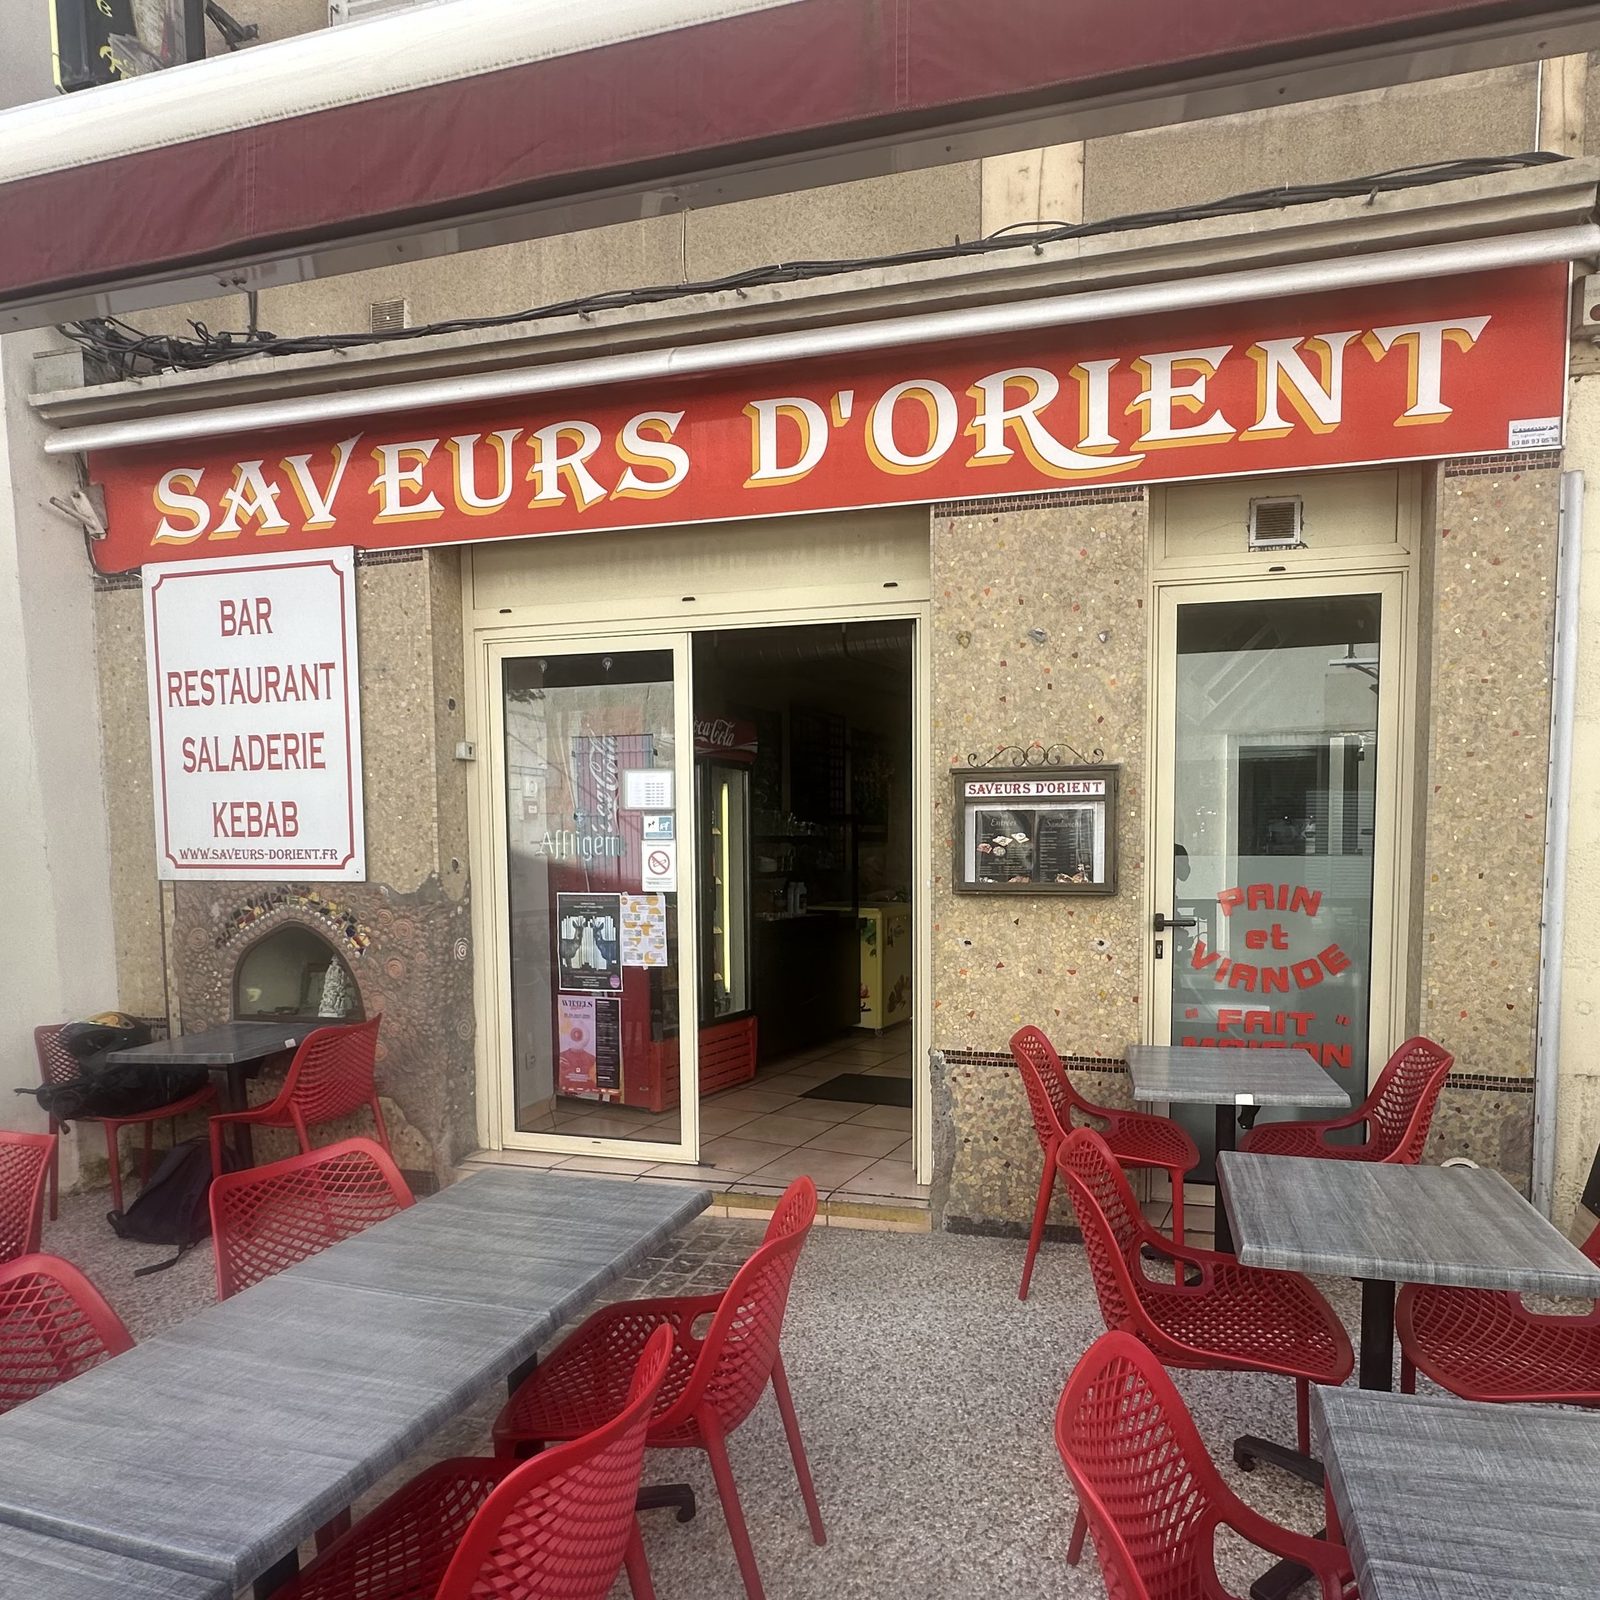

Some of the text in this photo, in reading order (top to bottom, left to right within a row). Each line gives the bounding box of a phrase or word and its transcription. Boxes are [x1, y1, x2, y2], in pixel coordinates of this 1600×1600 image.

[150, 315, 1491, 546] SAVEURS D'ORIENT
[219, 597, 273, 637] BAR
[167, 662, 336, 708] RESTAURANT
[182, 731, 326, 773] SALADERIE
[968, 781, 1102, 795] SAVEURS D'ORIENT
[212, 800, 299, 838] KEBAB
[179, 848, 338, 861] WWW.SAVEURS-DORIENT.FR
[1217, 883, 1323, 917] PAIN
[1245, 923, 1289, 950] et
[1191, 943, 1352, 993] VIANDE
[1217, 1008, 1317, 1036] FAIT
